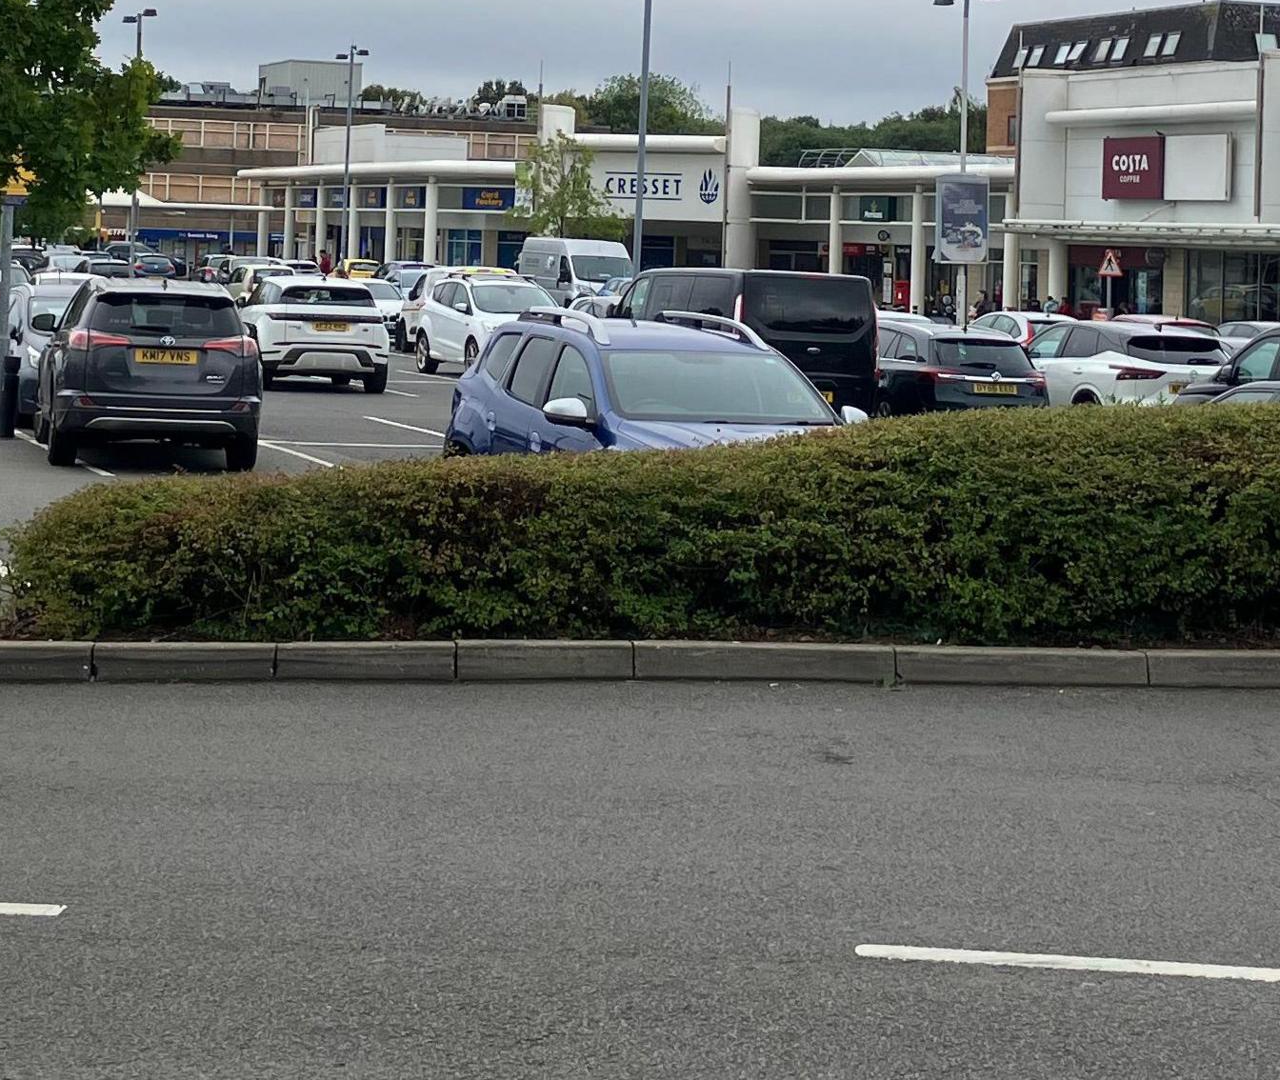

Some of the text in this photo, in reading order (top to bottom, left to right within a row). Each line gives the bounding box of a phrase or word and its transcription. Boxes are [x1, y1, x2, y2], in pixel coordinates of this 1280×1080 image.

[1112, 154, 1149, 173] COSTA
[605, 177, 682, 196] CRESSET
[168, 351, 191, 362] VNS
